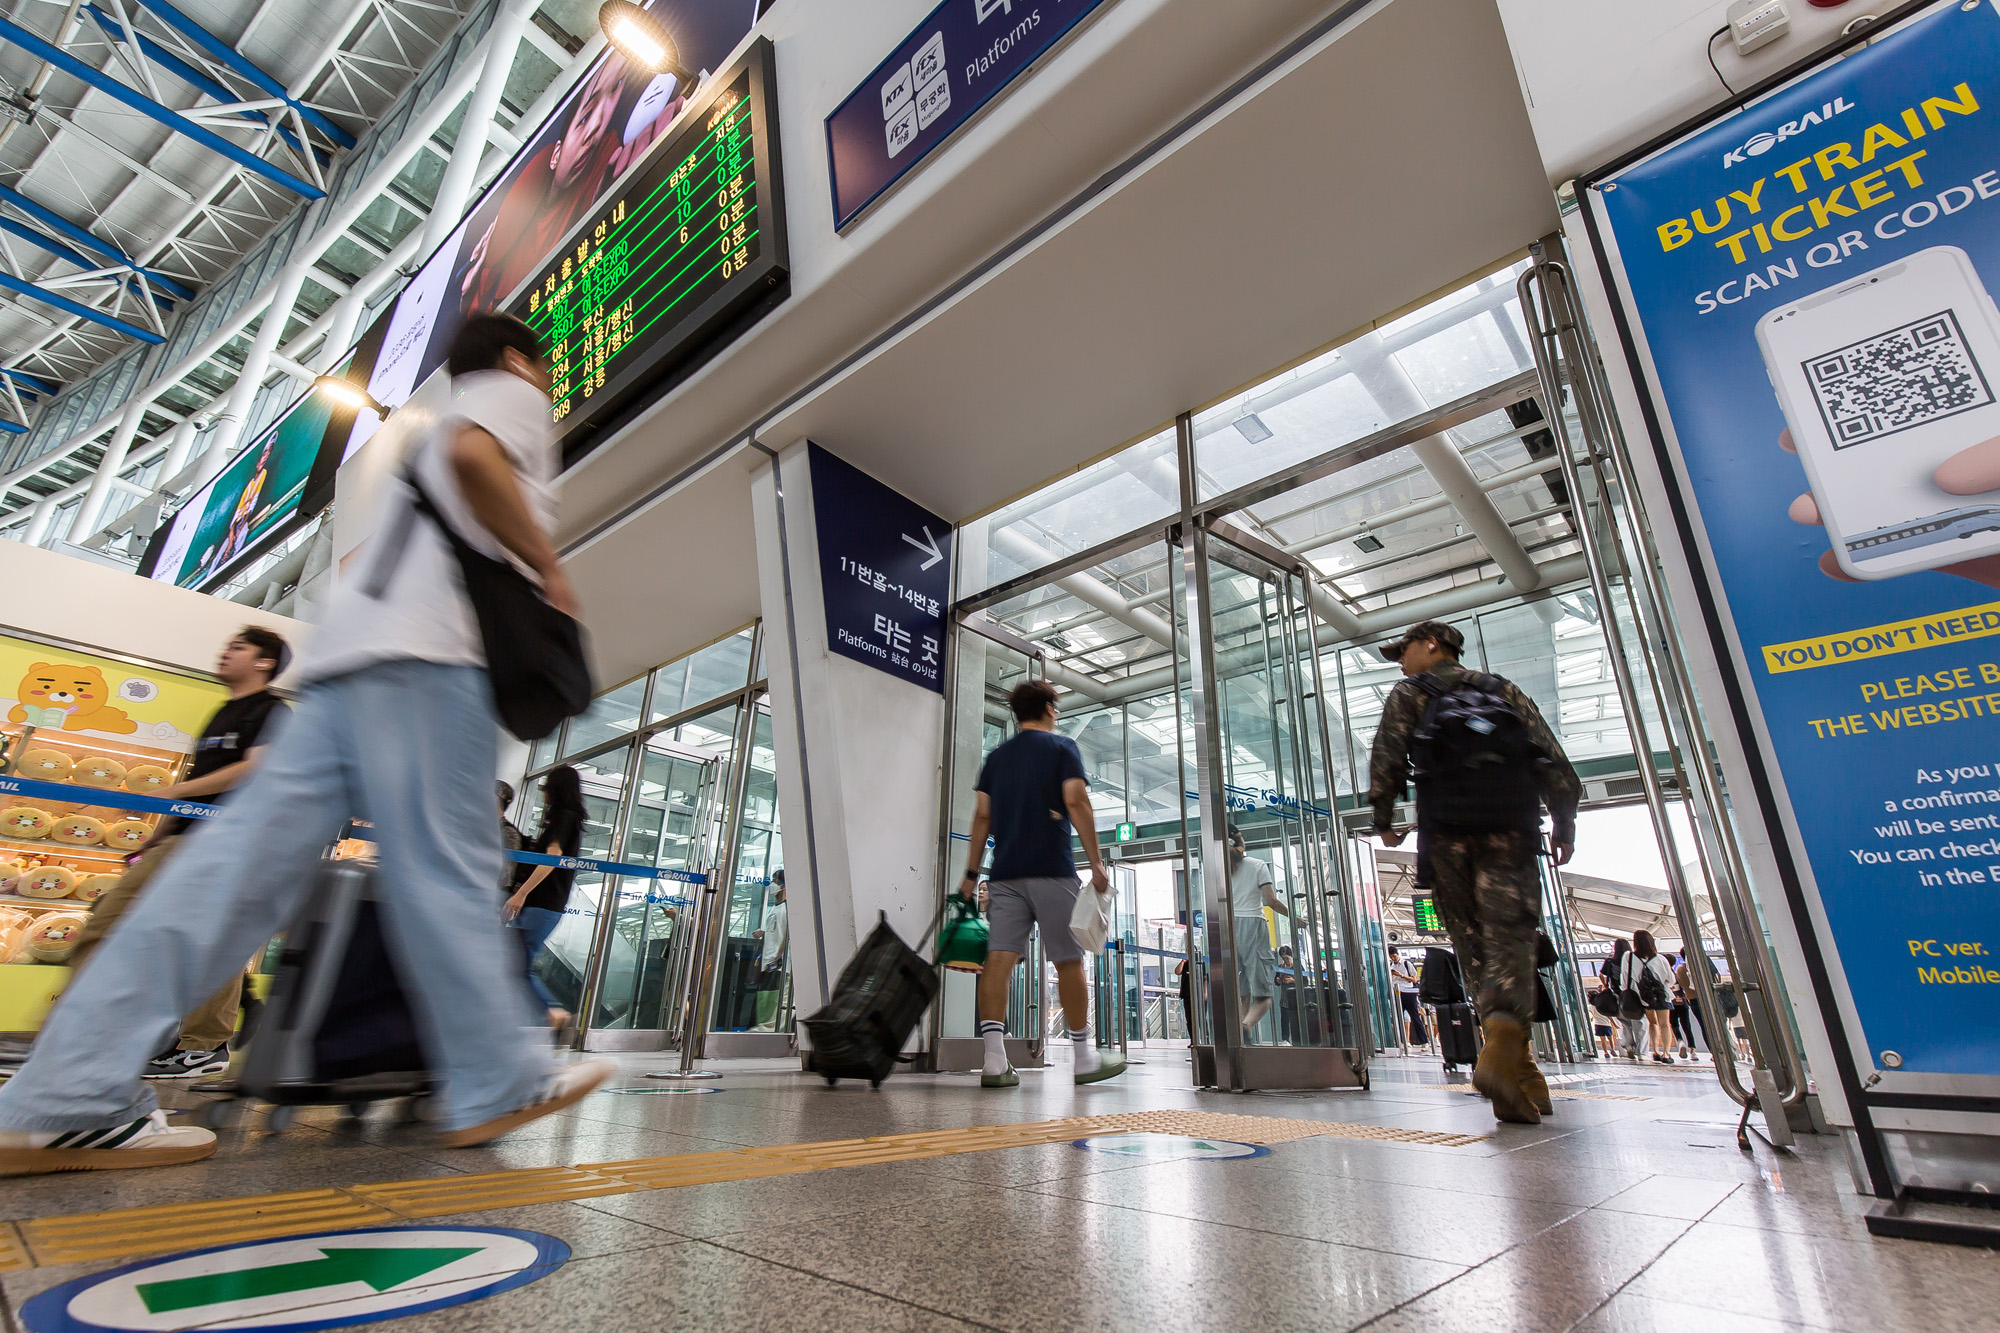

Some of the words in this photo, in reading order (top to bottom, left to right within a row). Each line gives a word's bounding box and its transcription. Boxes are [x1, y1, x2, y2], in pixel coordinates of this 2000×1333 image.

[966, 8, 1041, 85] Platforms
[885, 75, 910, 108] KTX
[920, 82, 947, 112] 무궁화
[707, 95, 738, 132] KORAIL
[1723, 97, 1855, 169] KORAIL
[669, 153, 697, 188] 타는곳
[716, 115, 735, 142] 지연
[1656, 177, 1766, 253] BUY
[1774, 82, 1981, 194] TRAIN
[1715, 149, 1928, 265] TICKET
[552, 299, 569, 325] 507
[581, 240, 629, 295] 여수EXPO
[676, 179, 691, 203] 10
[1694, 257, 1799, 315] SCAN
[1805, 230, 1869, 268] QR
[1874, 170, 2000, 239] CODE
[552, 312, 575, 344] 9507
[581, 260, 629, 314] 여수EXPO
[677, 200, 692, 224] 10
[552, 338, 568, 364] 021
[582, 304, 605, 334] 부산
[680, 226, 689, 244] 6
[552, 357, 570, 384] 234
[582, 297, 633, 357] 서울/행신
[552, 377, 570, 404] 204
[583, 319, 634, 377] 서울/행신
[553, 398, 571, 423] 809
[583, 366, 606, 398] 강릉
[838, 628, 887, 659] Platforms
[891, 652, 909, 669] 站台
[874, 613, 912, 654] 타는
[921, 635, 939, 666] 곳
[1771, 644, 1827, 668] YOU
[1830, 626, 1918, 659] DON'T
[1922, 610, 2000, 641] NEED
[1860, 667, 1976, 704] PLEASE
[1808, 714, 1868, 740] THE
[1869, 693, 2000, 731] WEBSITE
[1916, 768, 1943, 784] As
[1945, 765, 1990, 785] you
[169, 803, 221, 818] KORAIL
[1262, 789, 1301, 810] KORAIL
[1884, 799, 1898, 813] a
[1902, 788, 2000, 809] confirma
[1874, 819, 1913, 838] will
[1915, 819, 1946, 835] be
[1949, 814, 2000, 832] sent
[558, 858, 599, 871] KORAIL
[656, 870, 691, 882] KORAIL
[1849, 849, 1892, 865] You
[1895, 847, 1935, 862] can
[1918, 870, 1943, 886] in
[1945, 867, 1986, 884] the
[1908, 939, 1942, 957] PC
[1943, 942, 1989, 956] ver.
[1917, 965, 2000, 984] Mobile
